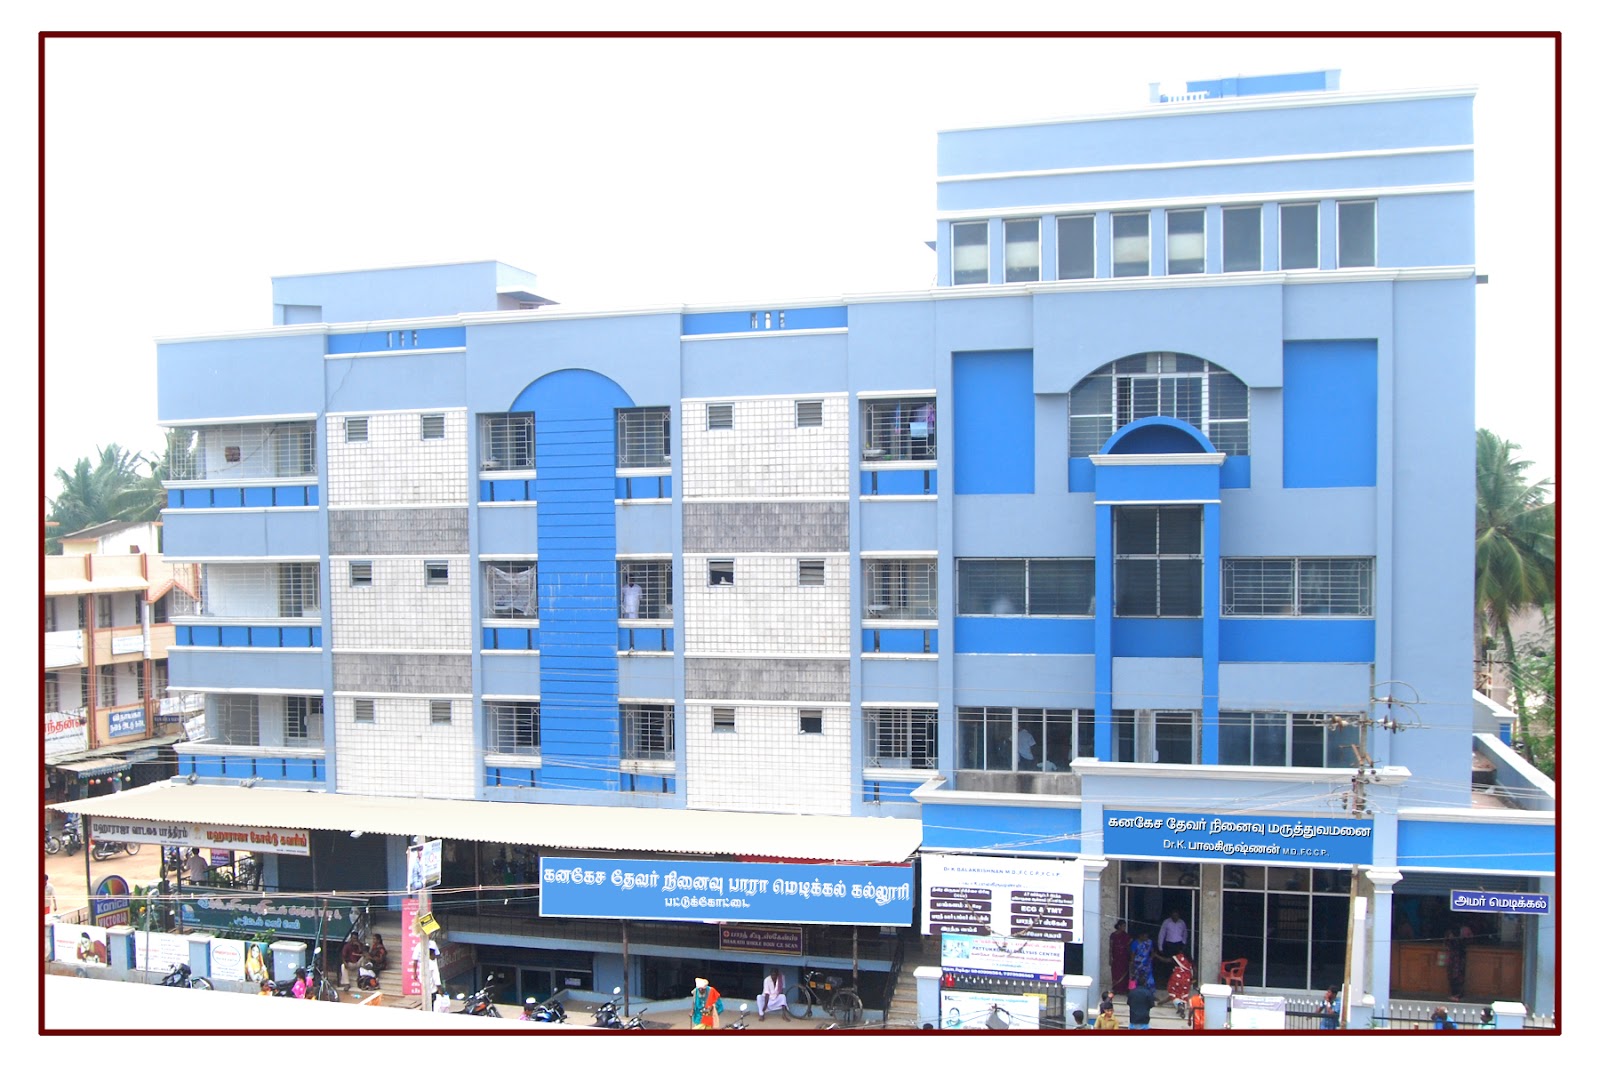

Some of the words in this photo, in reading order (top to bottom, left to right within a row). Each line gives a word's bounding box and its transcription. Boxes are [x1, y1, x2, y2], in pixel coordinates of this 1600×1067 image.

[93, 823, 129, 835] மஹாராஜா
[1108, 816, 1164, 829] கனகேச
[1167, 818, 1207, 832] தேவர்
[1209, 819, 1265, 835] நினைவு
[1267, 823, 1372, 838] மருத்துவமனை
[1163, 839, 1187, 850] Dr.K.
[1188, 841, 1281, 855] பாலகிருஷ்ணன்
[543, 867, 607, 885] கனகேச
[611, 869, 660, 891] தேவர்
[661, 870, 724, 896] நினைவு
[728, 877, 769, 896] பாரா
[772, 877, 847, 899] மெடிக்கல்
[851, 881, 910, 906] கல்லூரி
[96, 900, 128, 914] Konica
[664, 895, 750, 909] பட்டுக்கோட்டை
[1021, 905, 1037, 913] ECG
[1454, 895, 1486, 906] அமர்
[1489, 896, 1547, 911] மெடிக்கல்
